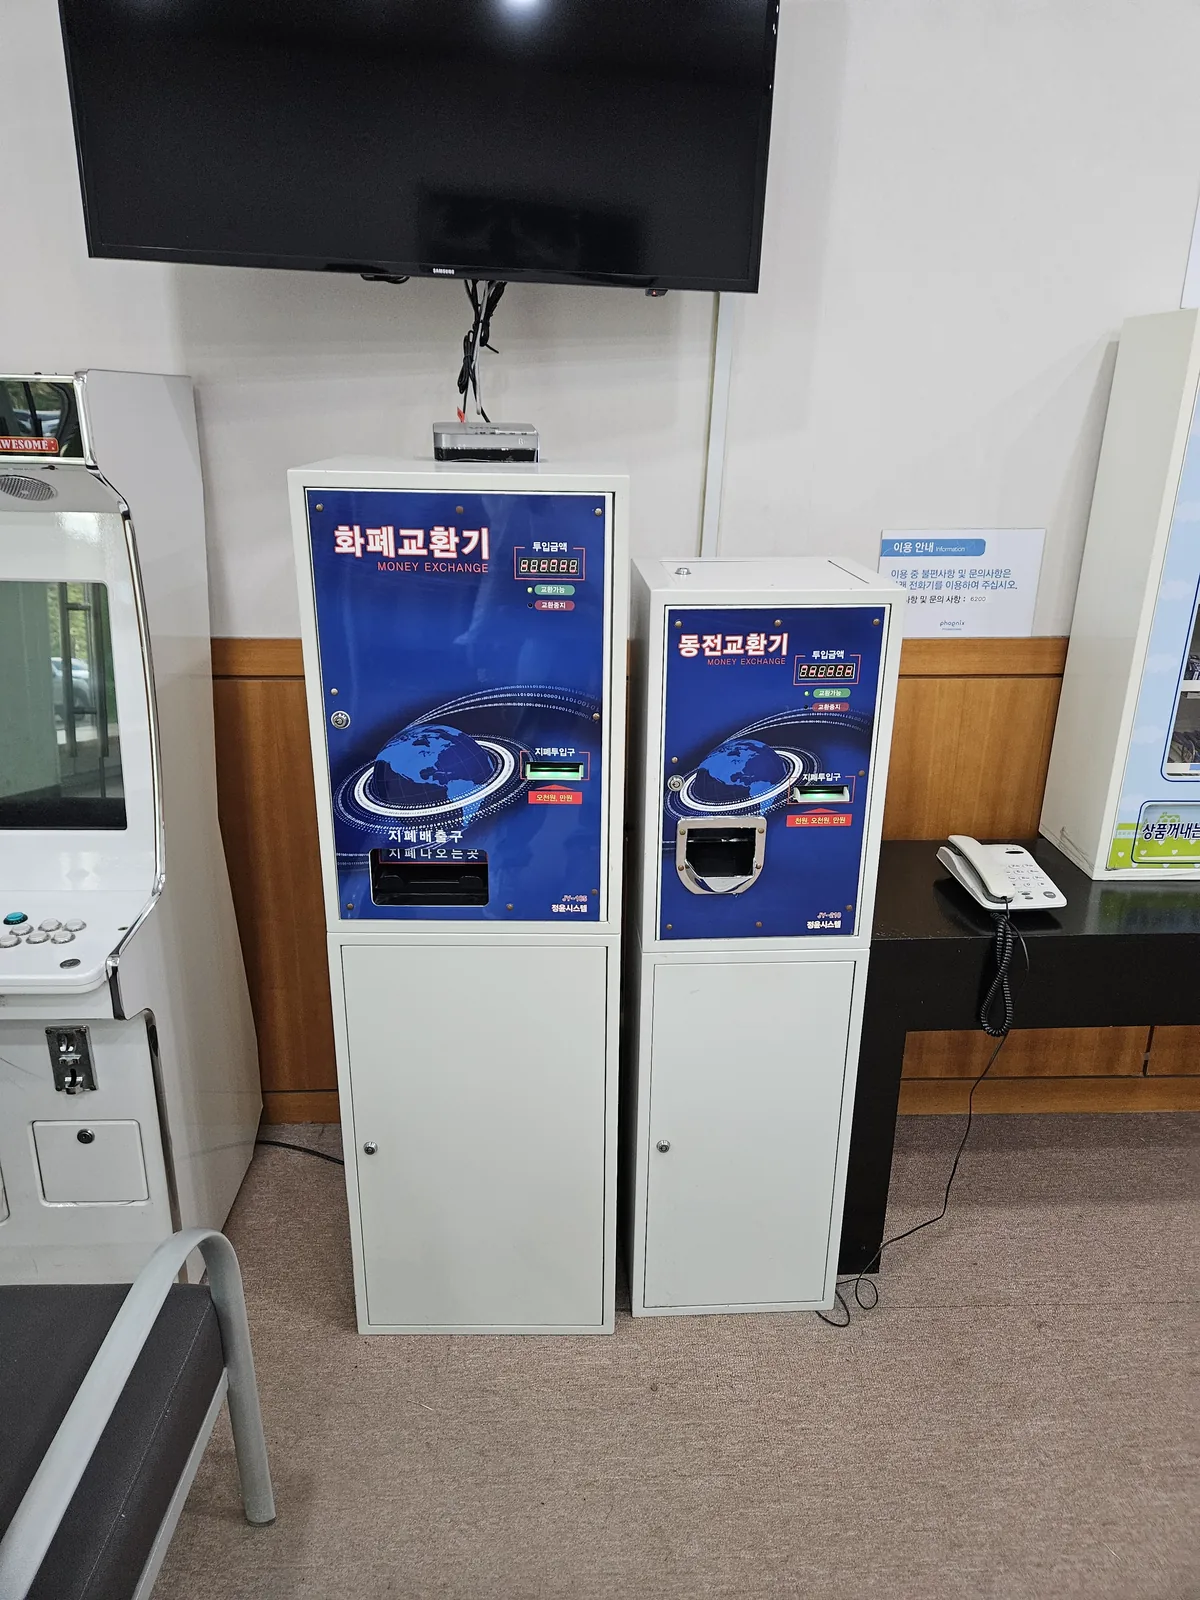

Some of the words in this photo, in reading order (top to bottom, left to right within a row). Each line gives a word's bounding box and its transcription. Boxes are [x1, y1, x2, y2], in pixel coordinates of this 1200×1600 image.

[334, 525, 490, 560] 화폐교환기
[532, 541, 568, 553] 투입금액
[893, 541, 913, 554] 이용
[915, 541, 935, 553] 안내
[377, 561, 419, 572] MONEY
[424, 562, 489, 573] EXCHANGE
[891, 569, 908, 579] 이용
[910, 569, 919, 579] 중
[921, 568, 956, 579] 불편사항
[958, 568, 967, 579] 및
[969, 568, 1012, 579] 문의사항은
[540, 586, 566, 594] 교환가능
[909, 580, 943, 590] 전화기를
[945, 580, 980, 590] 이용하여
[981, 580, 1018, 590] 주십시오.
[929, 595, 945, 604] 문의
[541, 601, 566, 609] 교환중지
[678, 632, 789, 658] 동전교환기
[811, 650, 845, 660] 투입금액
[707, 658, 737, 666] MONEY
[740, 657, 786, 665] EXCHANGE
[534, 747, 576, 757] 지폐투입구
[802, 772, 841, 782] 지폐투입구
[559, 794, 573, 802] 만원
[388, 829, 464, 844] 지폐배출구
[388, 848, 480, 860] 지폐나오는곳
